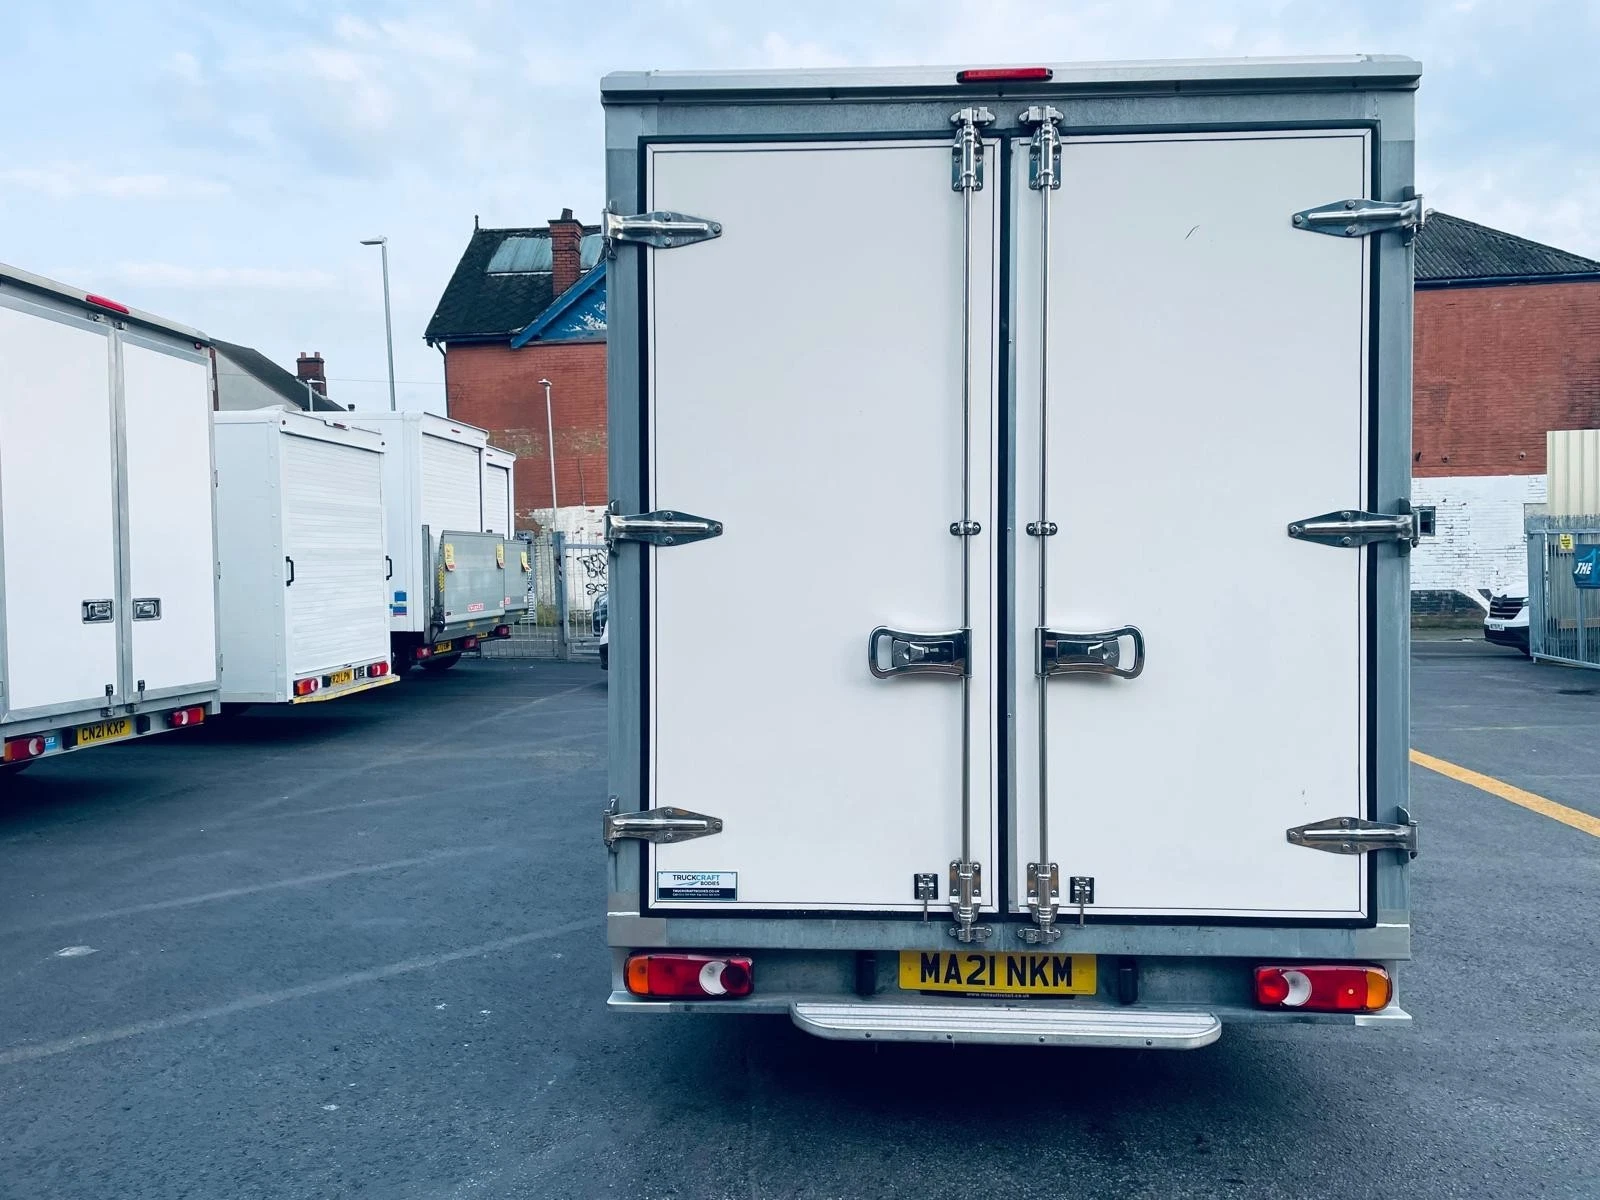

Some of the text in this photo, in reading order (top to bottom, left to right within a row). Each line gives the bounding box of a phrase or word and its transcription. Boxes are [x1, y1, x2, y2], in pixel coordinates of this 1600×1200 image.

[1574, 562, 1593, 575] THE
[82, 720, 126, 741] CN21 KXP
[920, 952, 1073, 987] MA21 NKM
